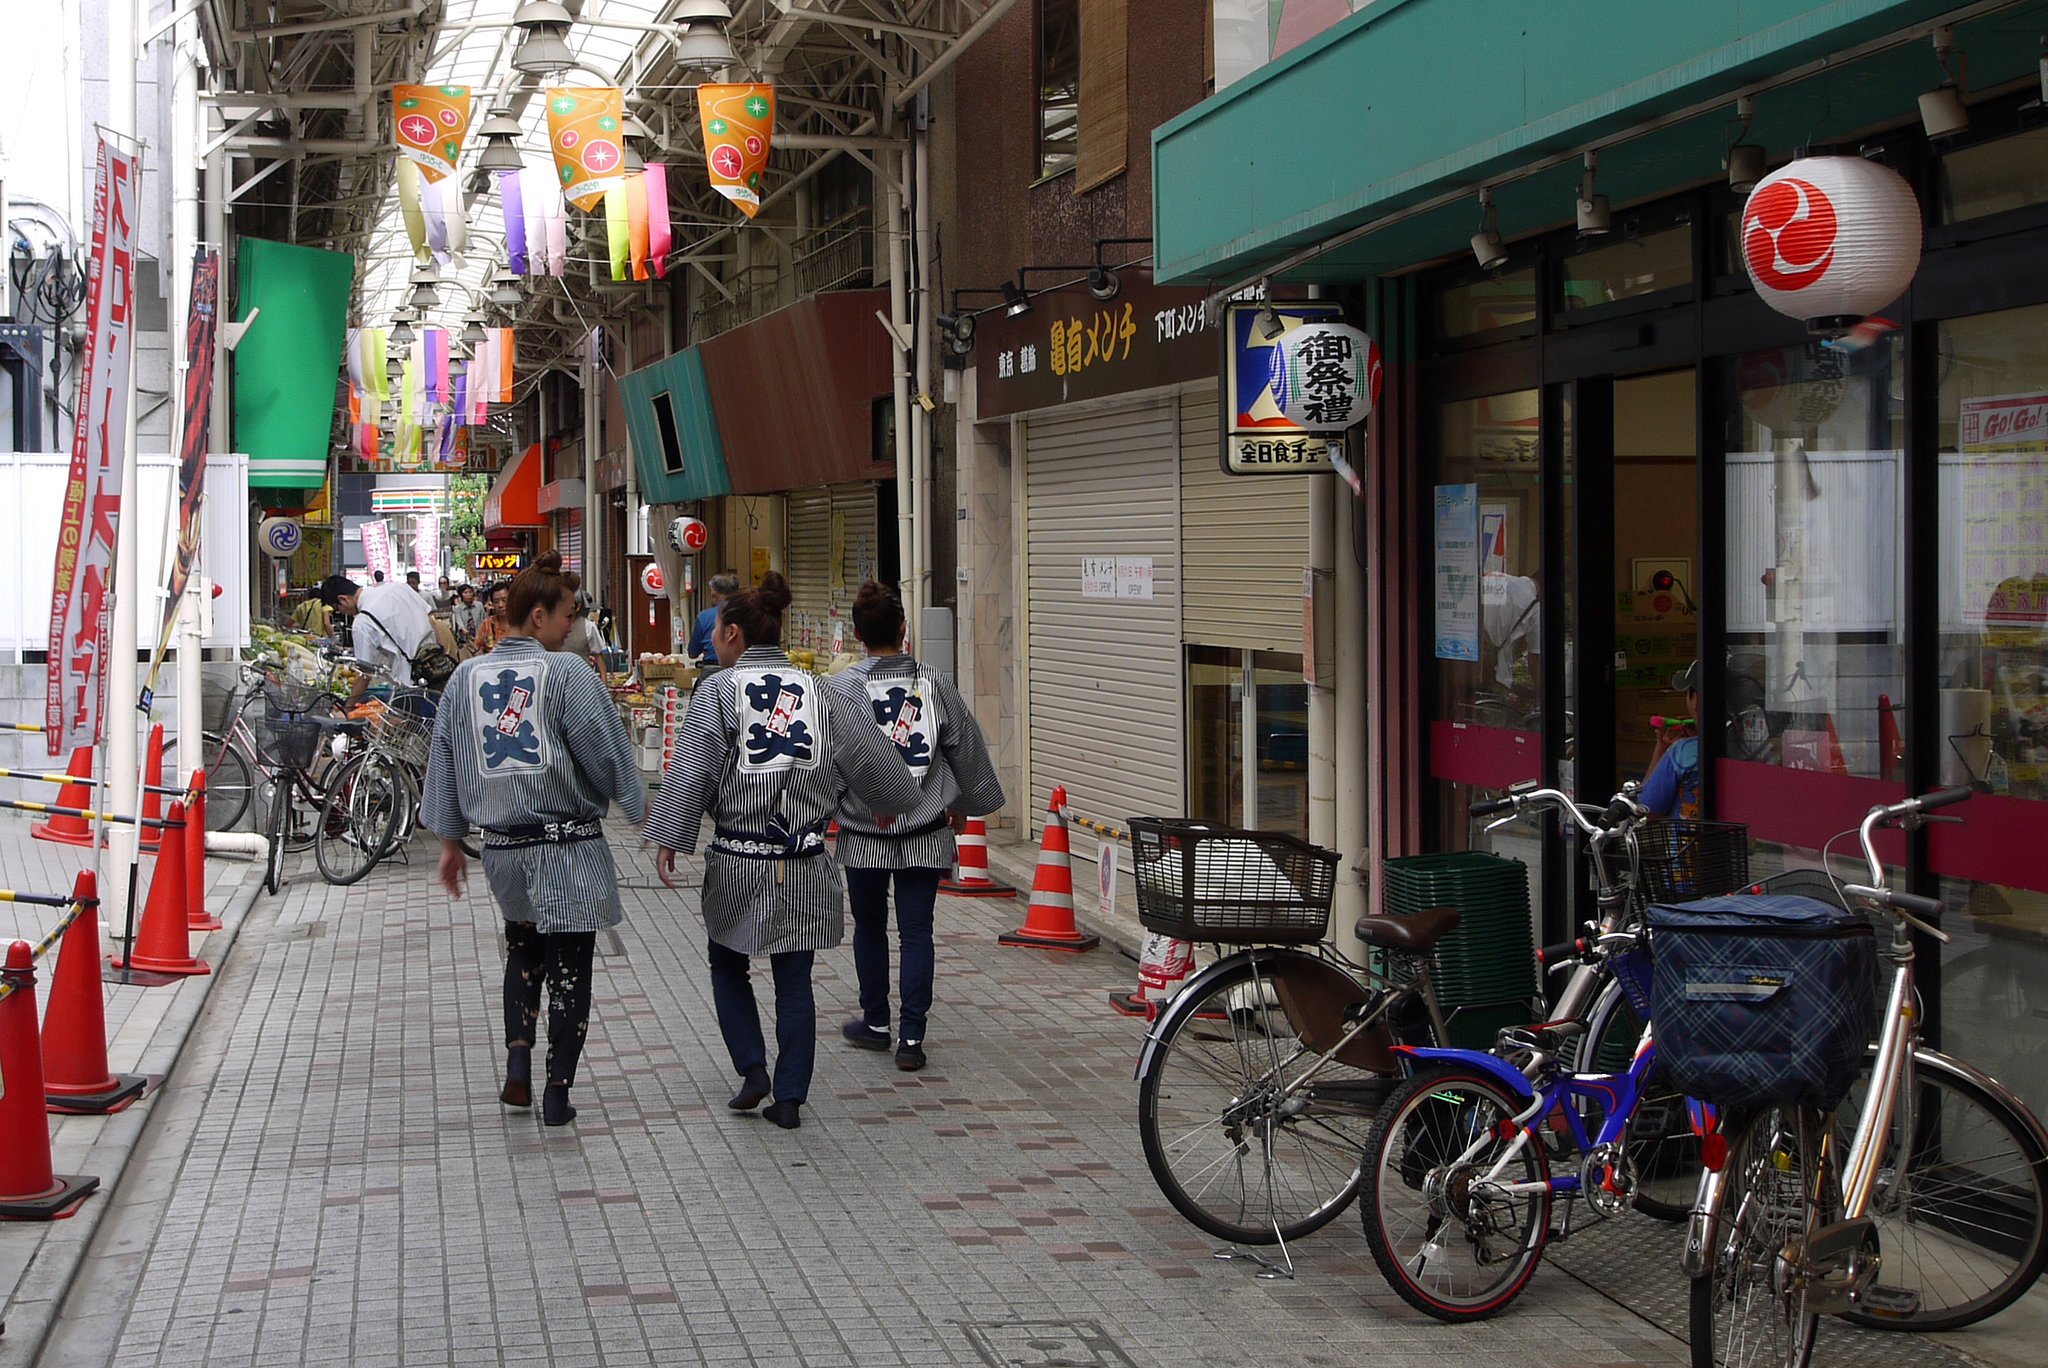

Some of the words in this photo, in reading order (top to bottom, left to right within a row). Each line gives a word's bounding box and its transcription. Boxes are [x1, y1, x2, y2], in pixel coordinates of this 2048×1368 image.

[998, 350, 1014, 379] 東京
[1020, 343, 1037, 374] 葛飾
[1050, 302, 1136, 376] 亀有メンチ
[1297, 330, 1355, 424] 御祭禮
[478, 554, 517, 569] バッグ
[479, 669, 542, 769] 中央
[745, 674, 813, 764] 中央
